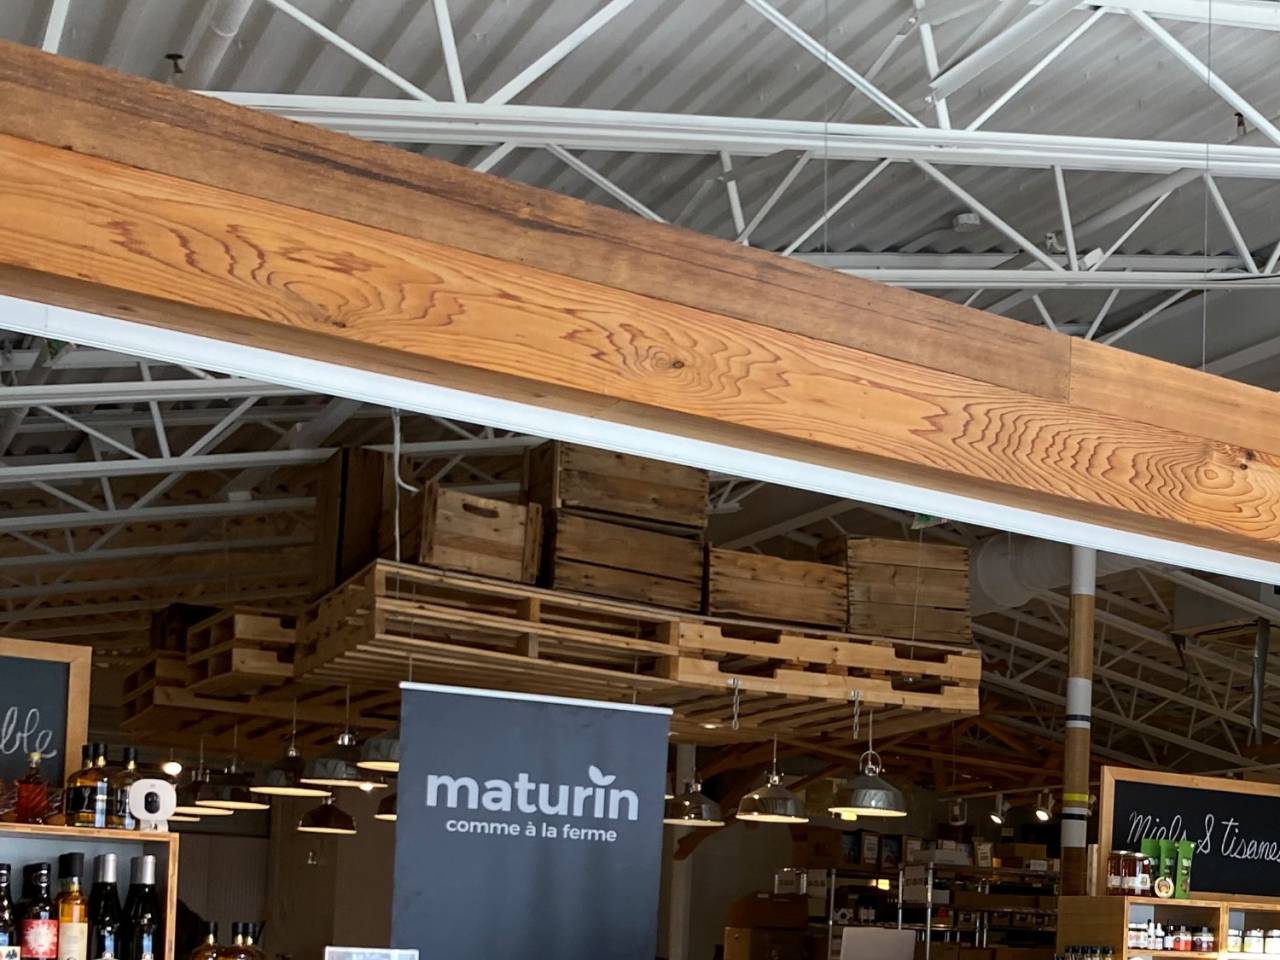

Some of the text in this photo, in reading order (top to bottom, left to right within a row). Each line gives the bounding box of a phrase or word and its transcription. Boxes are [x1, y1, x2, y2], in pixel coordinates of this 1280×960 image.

[426, 772, 639, 821] maturin
[445, 819, 618, 843] comme à la ferme
